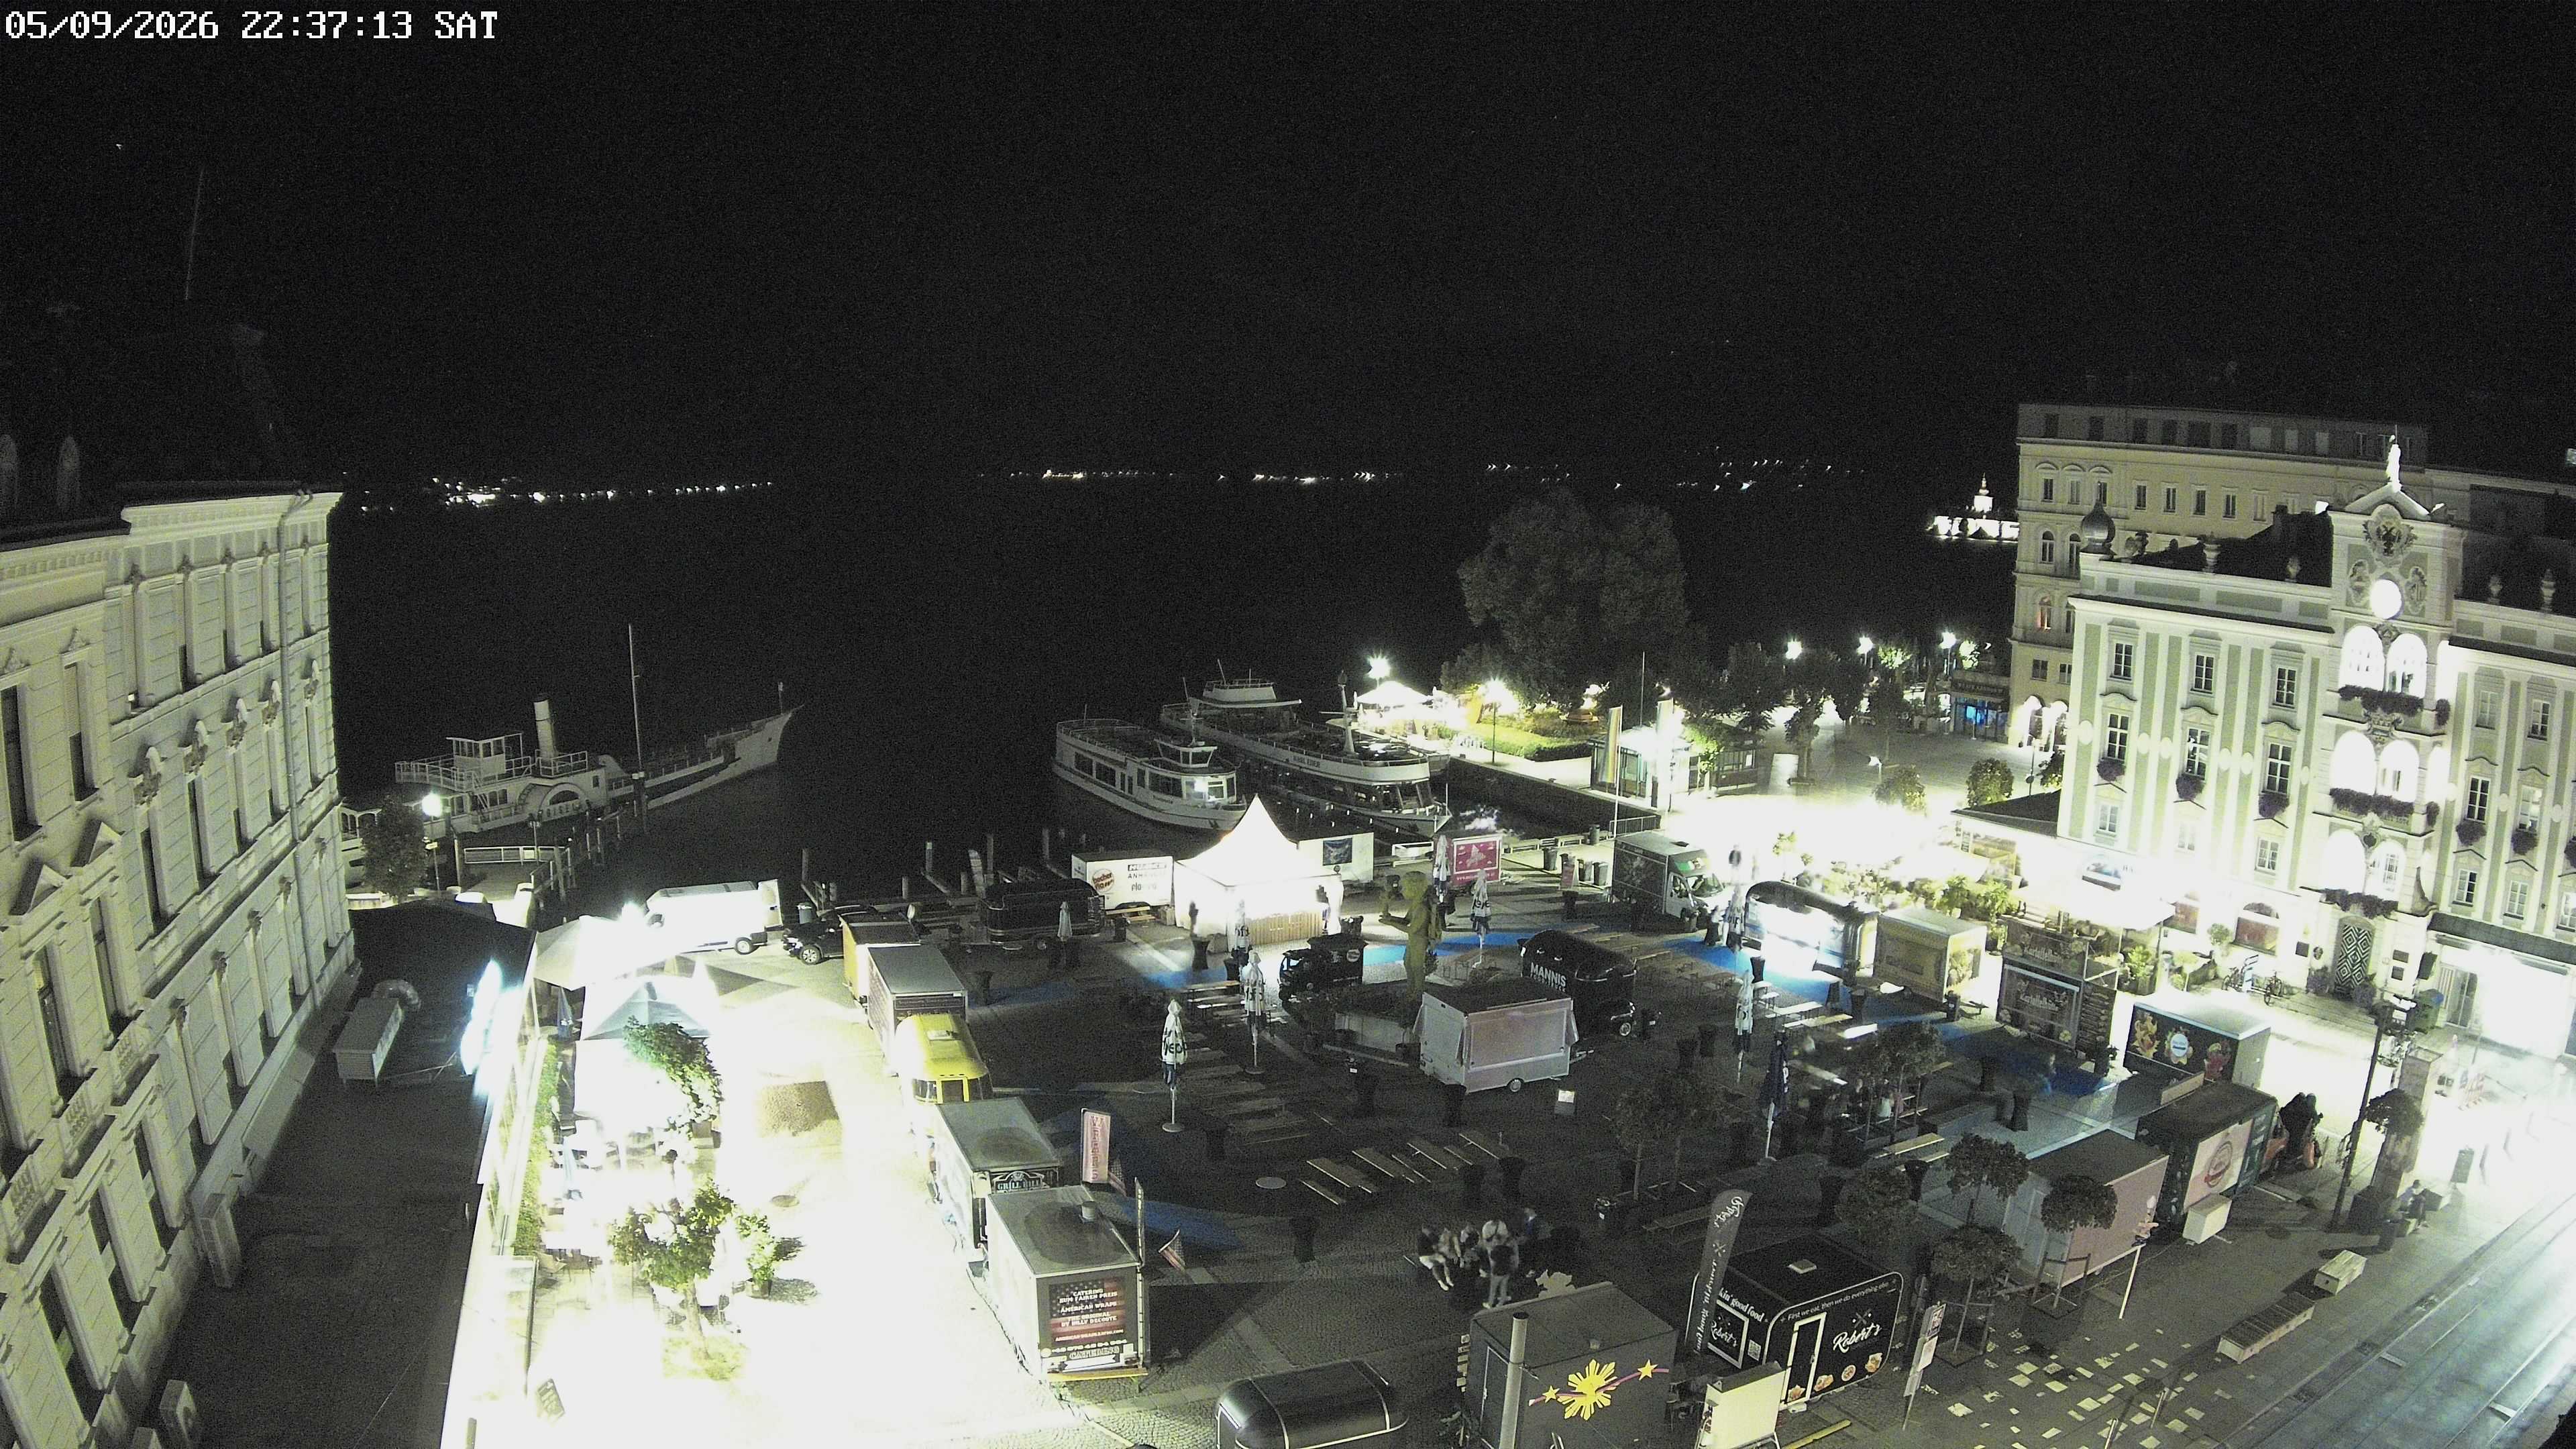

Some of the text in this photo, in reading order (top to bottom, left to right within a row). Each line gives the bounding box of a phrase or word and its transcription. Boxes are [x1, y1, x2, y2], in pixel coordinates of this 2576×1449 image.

[1530, 962, 1566, 987] MANNIS
[1731, 1298, 1750, 1314] good
[1748, 1306, 1764, 1322] food
[1833, 1322, 1882, 1354] Robert's
